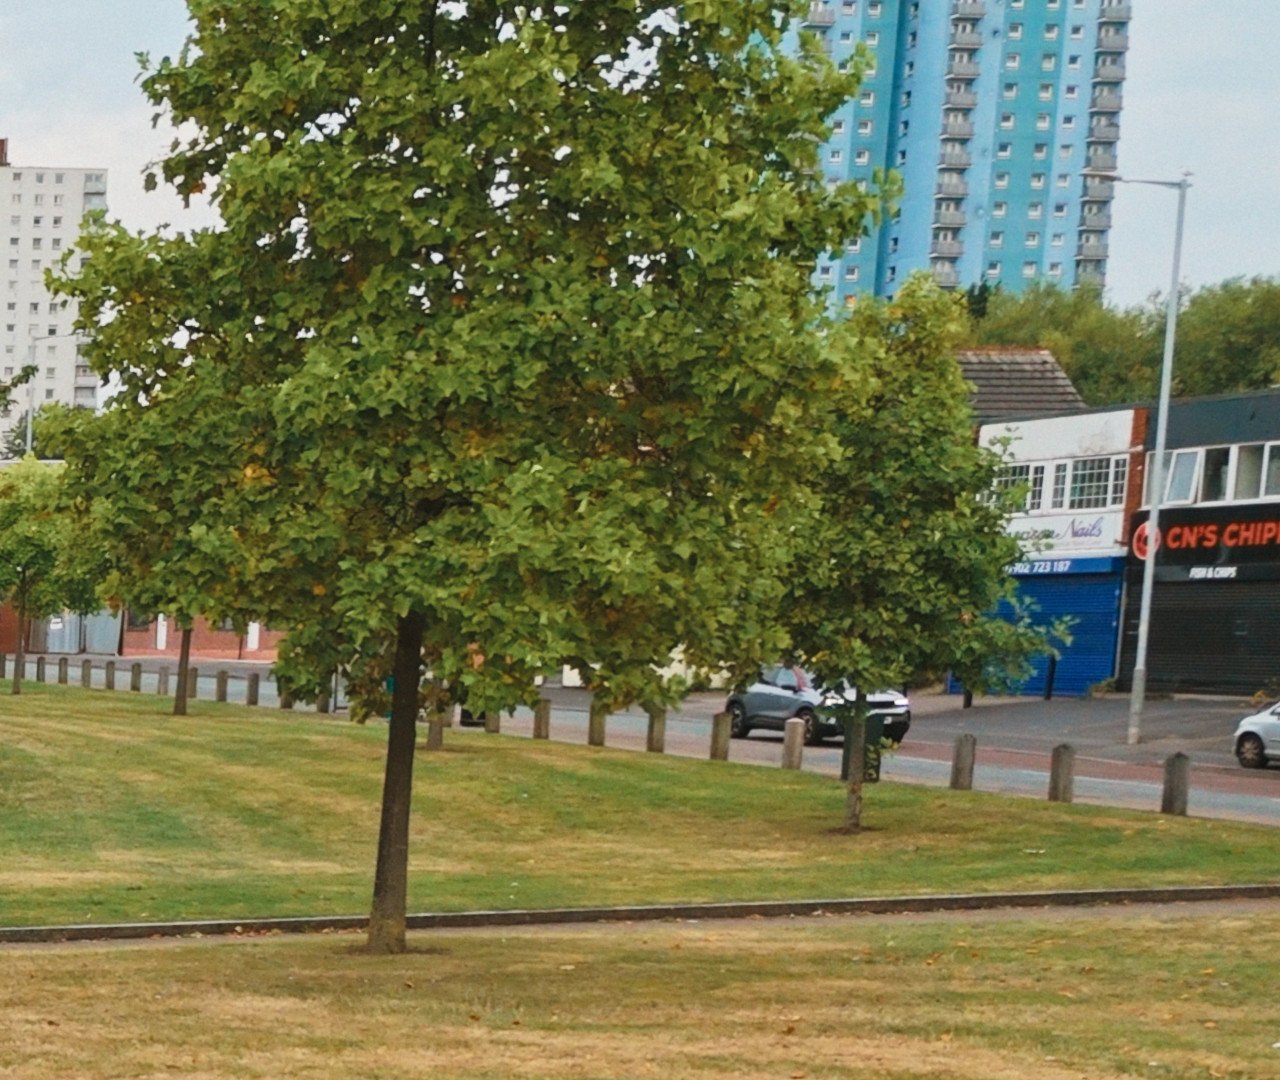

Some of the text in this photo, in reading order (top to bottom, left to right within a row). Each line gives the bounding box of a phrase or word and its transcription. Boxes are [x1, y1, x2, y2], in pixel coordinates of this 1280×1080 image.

[1060, 515, 1104, 539] Nails
[1165, 519, 1280, 550] CN'S CHIP
[1032, 561, 1051, 573] 723
[1188, 567, 1208, 579] FISH
[1213, 566, 1238, 578] CHIPS
